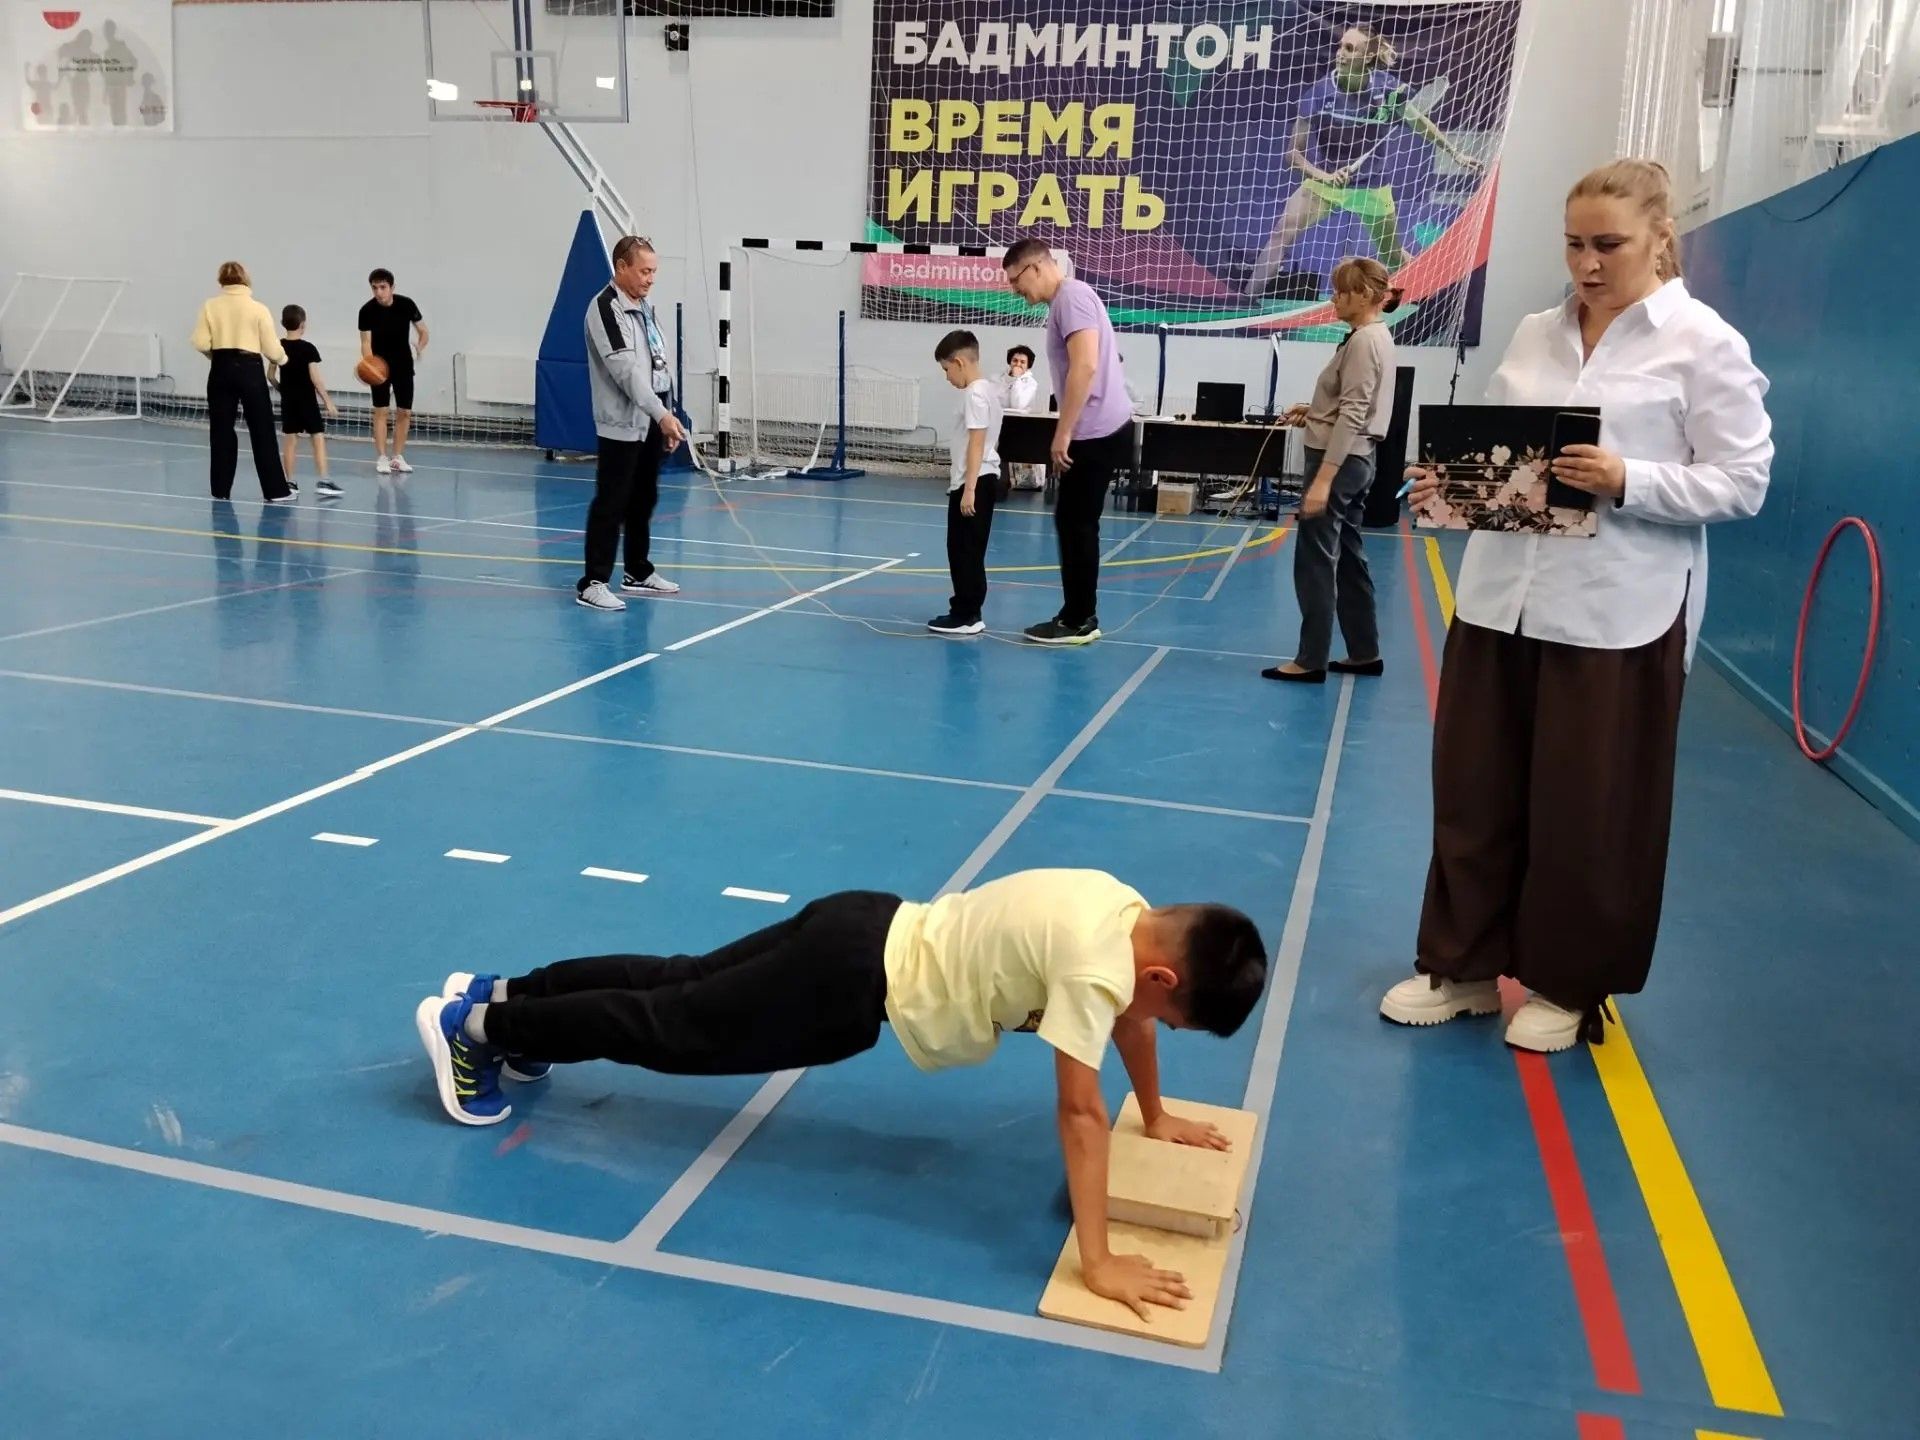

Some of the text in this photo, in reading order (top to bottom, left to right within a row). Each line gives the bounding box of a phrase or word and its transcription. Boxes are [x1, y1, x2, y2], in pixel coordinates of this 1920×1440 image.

[893, 21, 1273, 74] БАДМИНТОН
[890, 98, 1136, 159] ВРЕМЯ
[887, 168, 1166, 231] ИГРАТЬ
